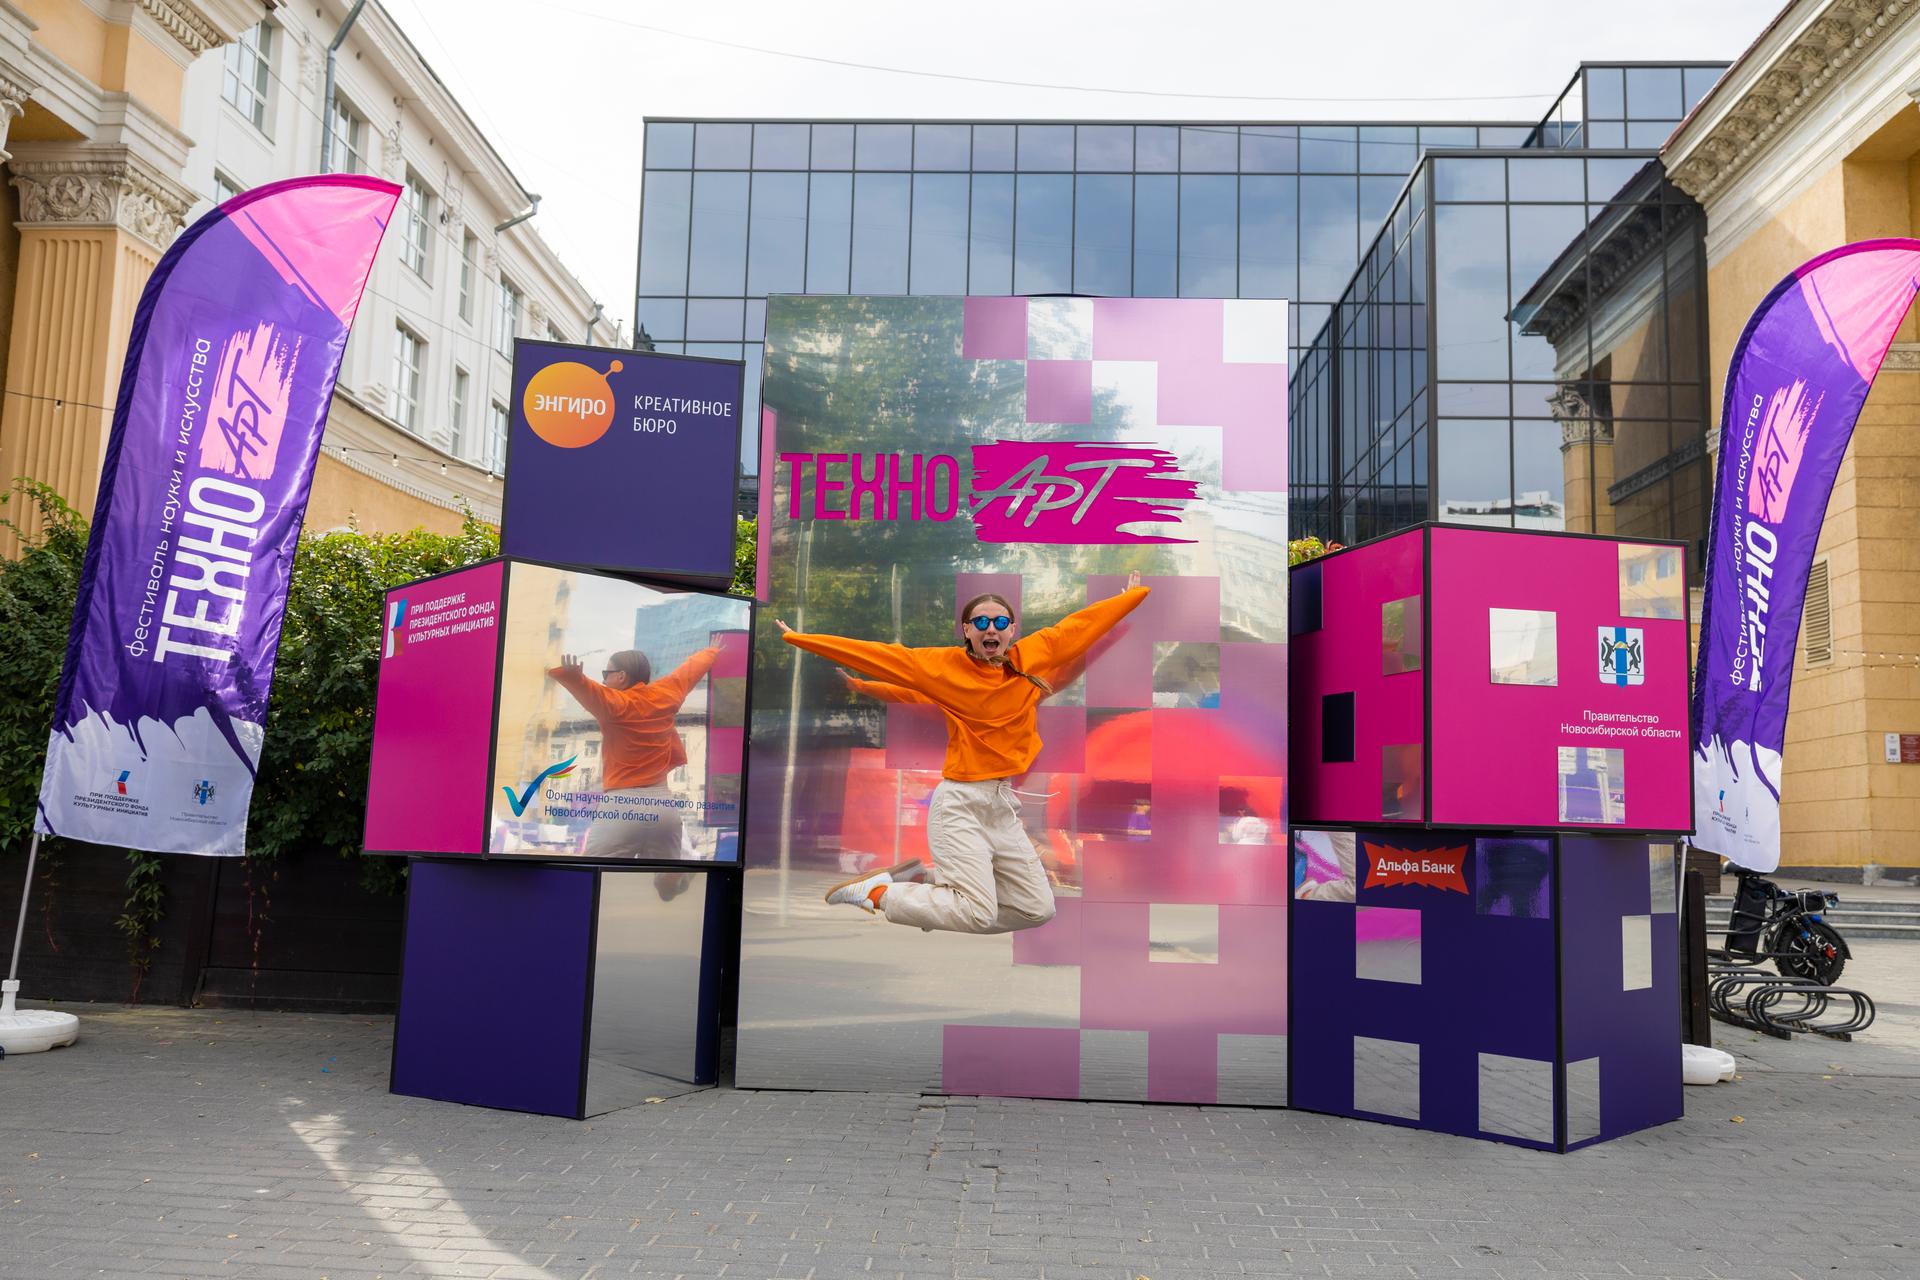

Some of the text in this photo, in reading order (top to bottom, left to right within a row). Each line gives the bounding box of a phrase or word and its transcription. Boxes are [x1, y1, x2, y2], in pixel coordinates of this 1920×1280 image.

[533, 394, 607, 420] энгиро
[634, 395, 732, 417] КРЕАТИВНОЕ
[633, 417, 677, 434] БЮРО
[125, 338, 211, 657] фестиваль науки и искусства
[780, 452, 1155, 528] ТЕХНО АРТ
[1729, 393, 1764, 686] фестиваль науки и искусства
[153, 476, 266, 663] ТЕХНО
[409, 601, 496, 630] ПРЕЗИДЕНТСКОГО ФОНДА
[410, 593, 466, 616] ПРИ ПОДДЕРЖКЕ
[408, 616, 494, 644] КУЛЬТУРНЫХ ИНИЦИАТИВ
[1583, 710, 1660, 724] Правительство
[1560, 723, 1681, 739] Новосибирской области
[545, 788, 736, 812] Фонд научно-технологического развития
[544, 805, 659, 823] Новосибирской области
[1376, 857, 1456, 876] Альфа Банк
